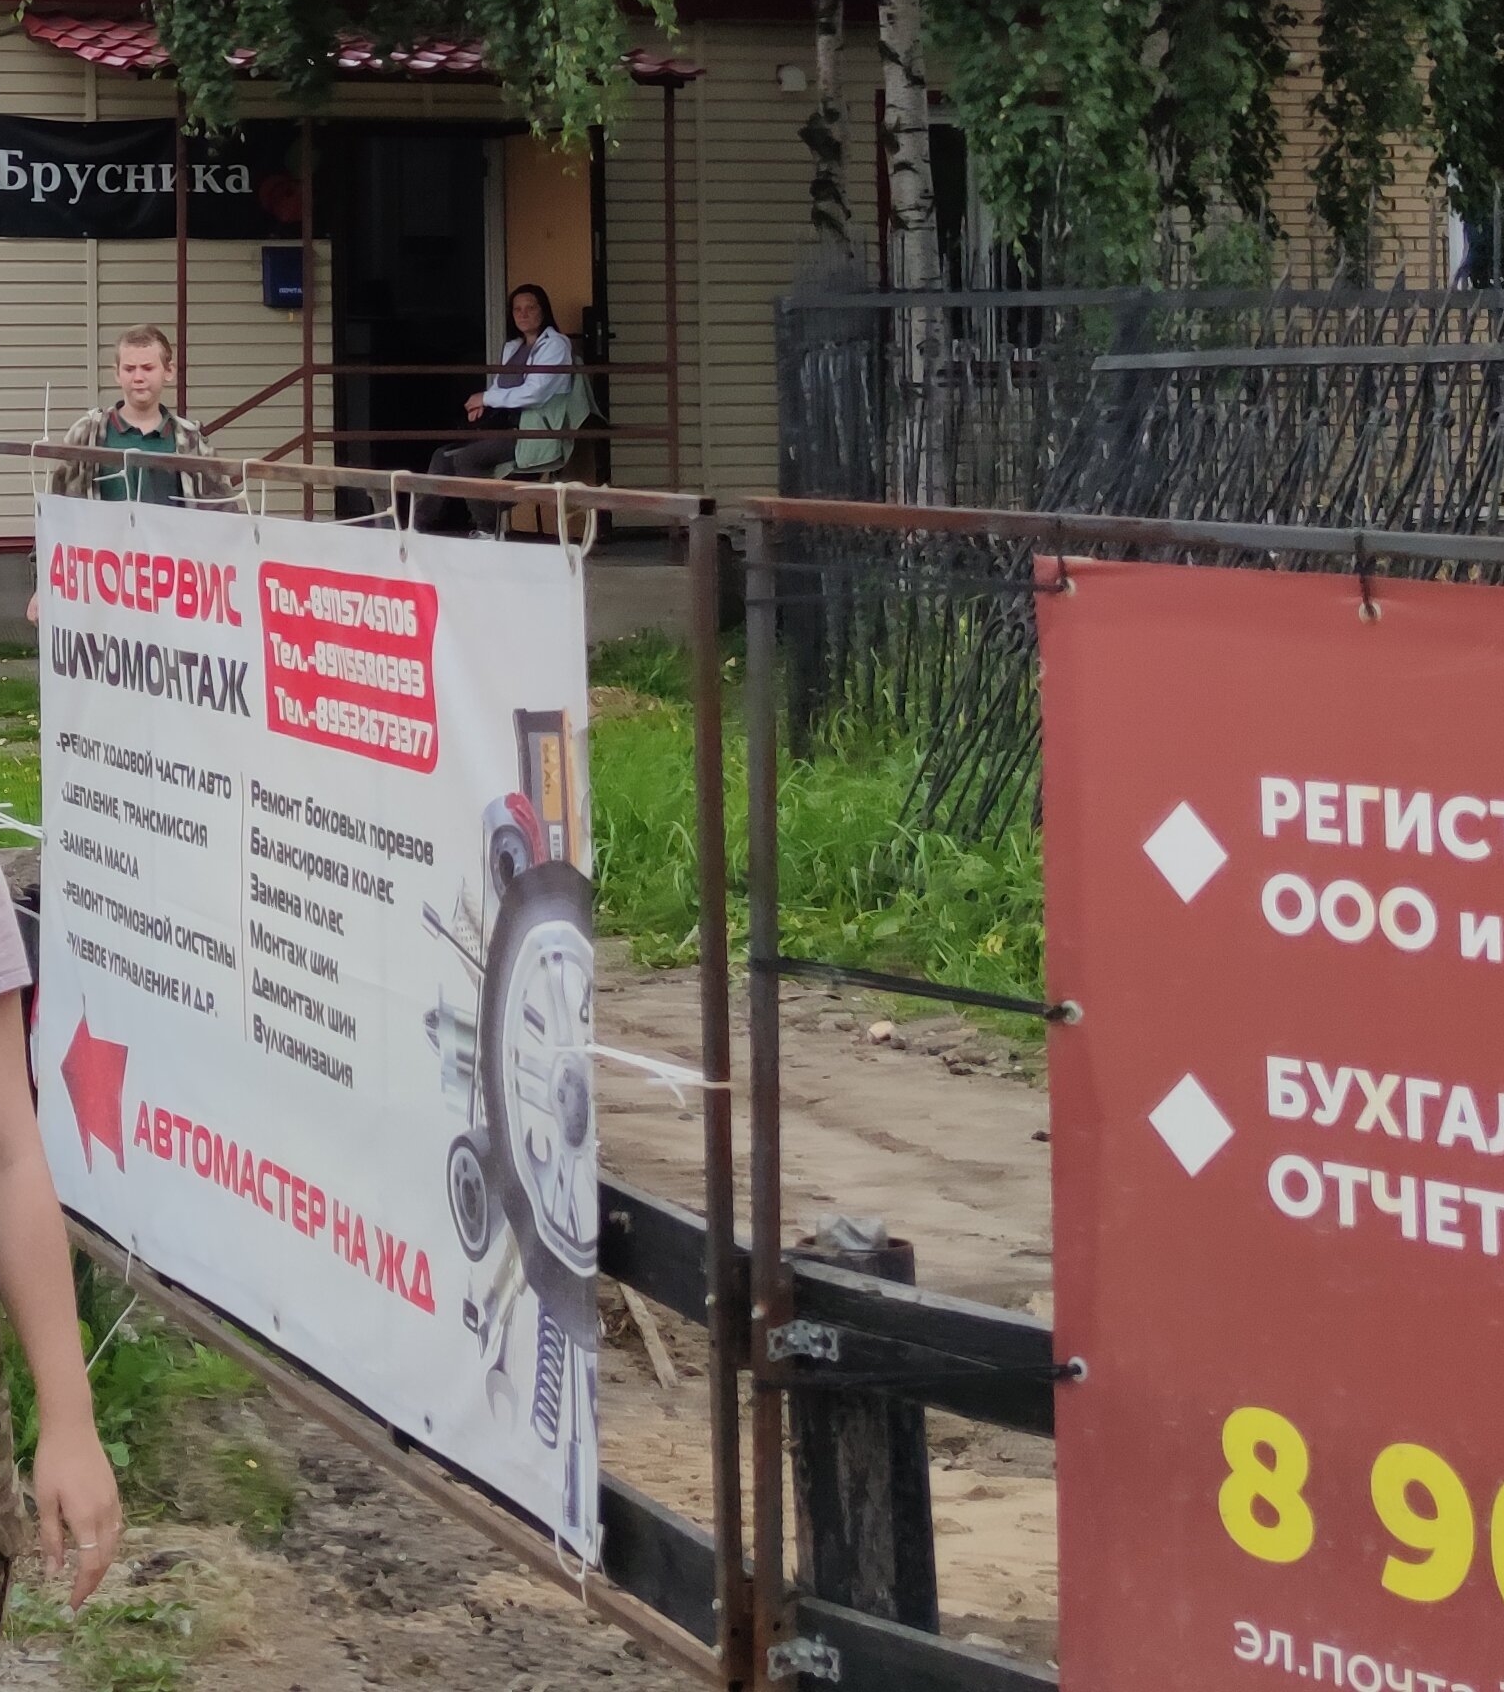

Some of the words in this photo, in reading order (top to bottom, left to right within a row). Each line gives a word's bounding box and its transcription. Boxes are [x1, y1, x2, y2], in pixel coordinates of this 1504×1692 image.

[49, 541, 243, 627] АВТОСЕРВИС
[51, 624, 252, 718] ШИНОМОНТАЖ
[102, 742, 154, 779] ХОДОВОЙ
[155, 757, 197, 790] ЧАСТИ
[197, 768, 233, 800] АВТО
[122, 800, 209, 849] ТРАНСМИССИЯ
[250, 778, 302, 823] Ремонт
[304, 795, 368, 845] боковых
[369, 823, 434, 867] порезов
[104, 844, 140, 881] МАСЛА
[249, 825, 349, 889] Балансировка
[351, 866, 395, 905] колес
[105, 896, 173, 946] ТОРМОЗНОЙ
[174, 925, 237, 971] СИСТЕМЫ
[249, 871, 302, 919] Замена
[303, 897, 345, 937] колес
[1260, 873, 1438, 951] ООО
[1459, 911, 1504, 963] и
[107, 949, 180, 1003] УПРАВЛЕНИЕ
[181, 980, 192, 1008] И
[249, 918, 308, 971] Монтаж
[310, 949, 339, 985] шин
[251, 966, 325, 1028] Демонтаж
[327, 1005, 357, 1043] шин
[252, 1012, 354, 1090] Вулканизация
[132, 1099, 327, 1240] АВТОМАСТЕР
[332, 1197, 371, 1278] НА
[373, 1224, 436, 1317] ЖД
[1218, 1406, 1315, 1563] 8
[1233, 1620, 1477, 1692] эл.почт
